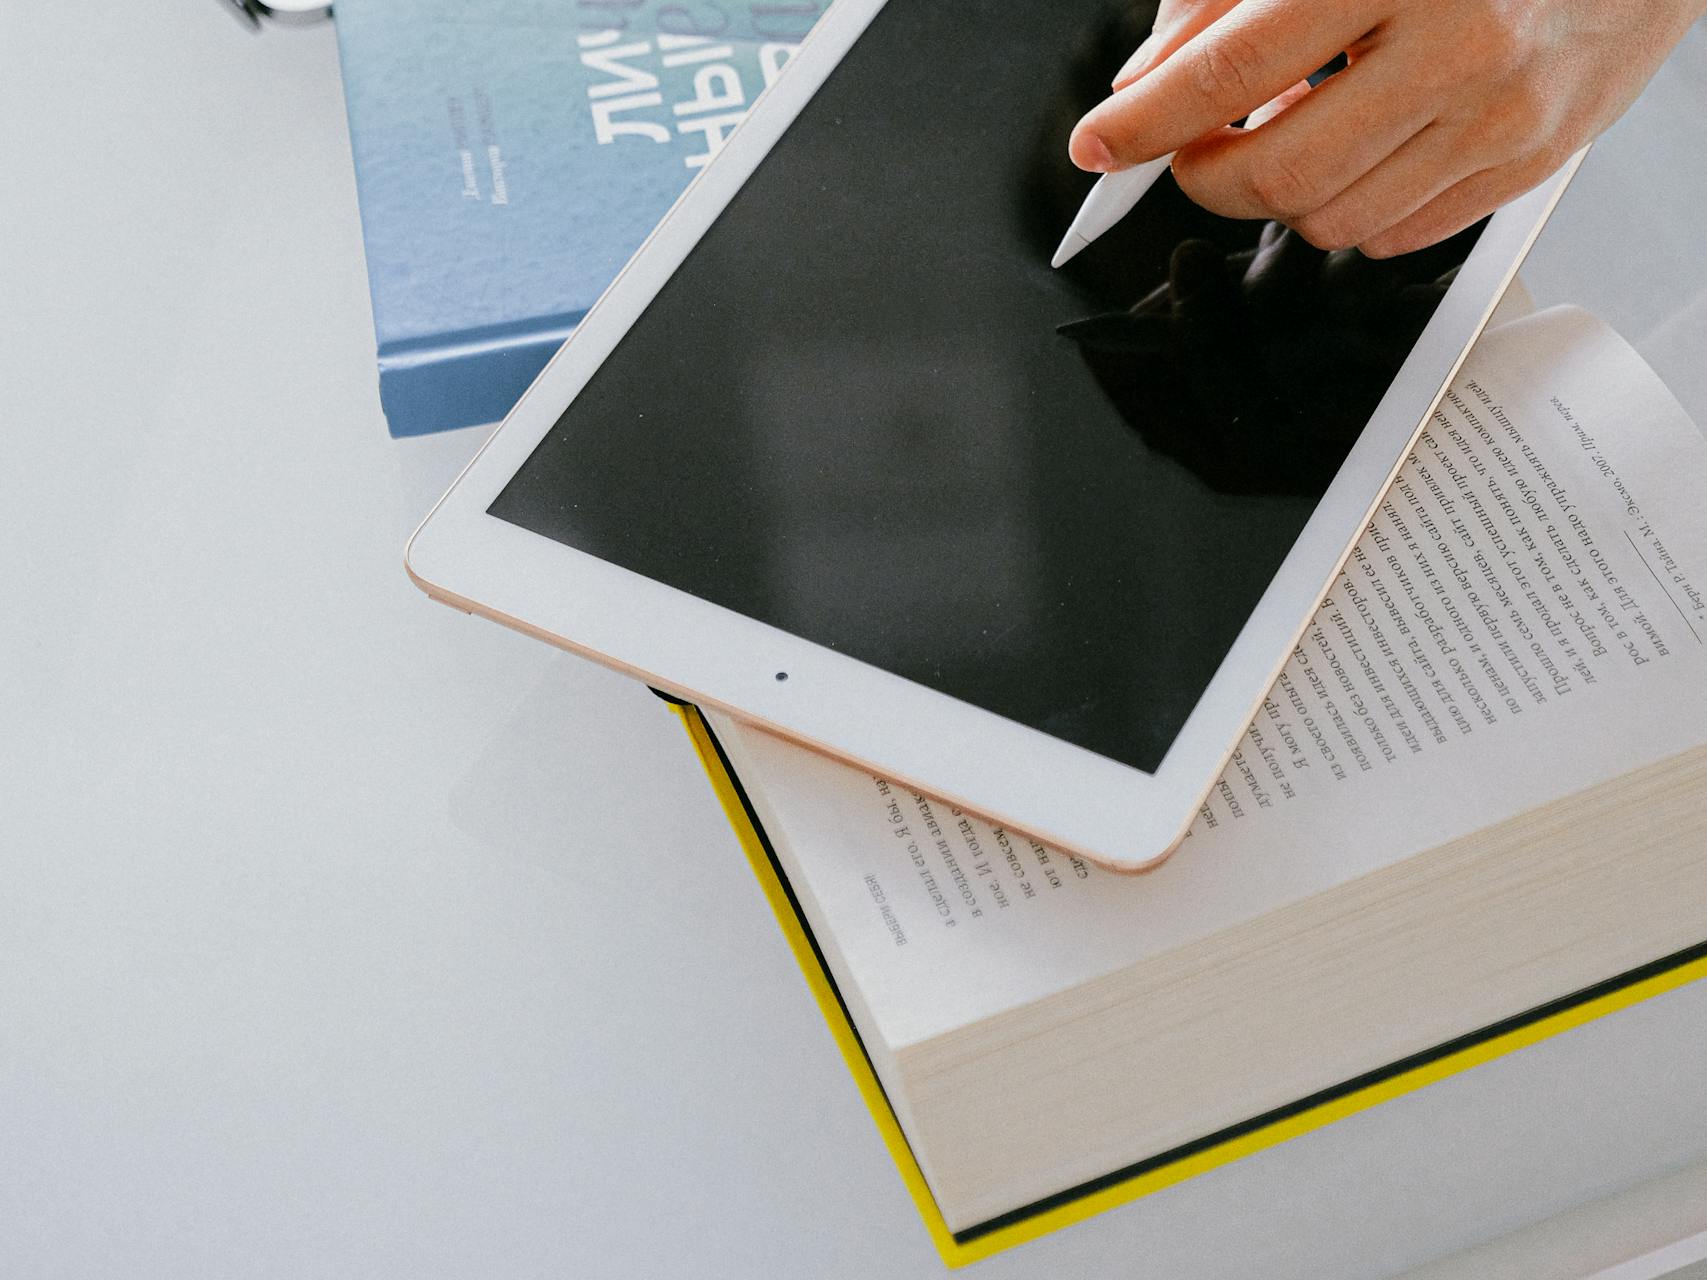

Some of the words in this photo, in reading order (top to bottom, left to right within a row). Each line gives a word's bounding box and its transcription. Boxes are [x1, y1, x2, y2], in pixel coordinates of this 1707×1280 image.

[1464, 379, 1493, 405] идей.
[1442, 386, 1496, 446] компактно
[1486, 405, 1525, 444] мышцу
[1447, 429, 1473, 455] идея
[1571, 421, 1597, 451] Прим.
[1433, 450, 1469, 490] проект
[1468, 455, 1487, 477] что
[1491, 447, 1519, 477] идею
[1591, 451, 1616, 478] 2007.
[1416, 466, 1456, 516] привлек
[1521, 444, 1577, 513] упражнять
[1398, 483, 1420, 506] под
[1487, 476, 1522, 526] понять,
[1514, 478, 1550, 522] любую
[1613, 477, 1640, 516] Эксмо,
[1378, 500, 1413, 541] нанял.
[1414, 505, 1442, 541] сайта
[1450, 518, 1475, 548] сайт
[1460, 490, 1516, 559] успешный
[1567, 513, 1594, 547] надо
[1638, 521, 1655, 538] М.
[1407, 541, 1420, 551] я
[1516, 526, 1537, 552] как
[1545, 524, 1582, 576] сделать
[1361, 563, 1376, 578] ее
[1413, 551, 1436, 578] них
[1437, 542, 1473, 591] версию
[1533, 551, 1556, 583] том,
[1588, 548, 1619, 585] этого
[1652, 537, 1678, 575] Тайна.
[1429, 578, 1446, 596] из
[1473, 549, 1513, 608] месяцев,
[1505, 560, 1531, 590] этот
[1551, 583, 1563, 593] в
[1577, 577, 1600, 601] как
[1672, 572, 1686, 584] Р.
[1370, 578, 1411, 636] вывесил
[1386, 554, 1457, 656] разработчиков
[1557, 593, 1575, 610] не
[1612, 585, 1640, 612] Для
[1681, 583, 1705, 611] Берн
[1342, 578, 1395, 657] инвесторов.
[1440, 596, 1474, 642] одного
[1466, 591, 1504, 641] первую
[1509, 609, 1534, 641] семь
[1525, 590, 1563, 637] продал
[1596, 601, 1620, 630] том,
[1468, 643, 1482, 654] и
[1557, 637, 1570, 647] я
[1569, 610, 1608, 658] Вопрос
[1616, 630, 1629, 640] в
[1632, 610, 1671, 657] вимой.
[1310, 627, 1356, 693] новостей,
[1329, 608, 1386, 694] инвестиций.
[1407, 635, 1437, 678] сайта,
[1564, 647, 1578, 658] и
[1622, 641, 1651, 667] рос
[1303, 666, 1329, 700] идея
[1477, 653, 1511, 697] ценам,
[1497, 640, 1548, 705] запустили
[1530, 642, 1572, 697] Прошло
[1572, 657, 1598, 685] лей,
[1260, 689, 1281, 720] пр
[1349, 693, 1369, 717] без
[1388, 657, 1448, 745] выдающихся
[1430, 679, 1455, 704] для
[1448, 657, 1498, 725] несколько
[1505, 697, 1523, 715] по
[1379, 694, 1404, 720] для
[1447, 705, 1473, 735] цию
[1274, 723, 1302, 755] могу
[1303, 716, 1336, 762] своего
[1324, 700, 1373, 772] появилась
[1363, 716, 1397, 764] только
[1395, 720, 1423, 755] идеи
[1292, 757, 1311, 770] Я
[1330, 763, 1348, 781] из
[872, 773, 891, 797] на
[1279, 781, 1297, 800] не
[886, 797, 904, 825] бы,
[893, 825, 912, 839] Я
[957, 818, 984, 858] тогда
[907, 840, 926, 868] его.
[992, 825, 1026, 878] совсем
[935, 838, 977, 907] создании
[974, 861, 993, 877] И
[1044, 868, 1063, 890] ют
[918, 869, 951, 917] сделал
[1019, 881, 1037, 900] не
[945, 918, 957, 928] а
[971, 907, 983, 919] в
